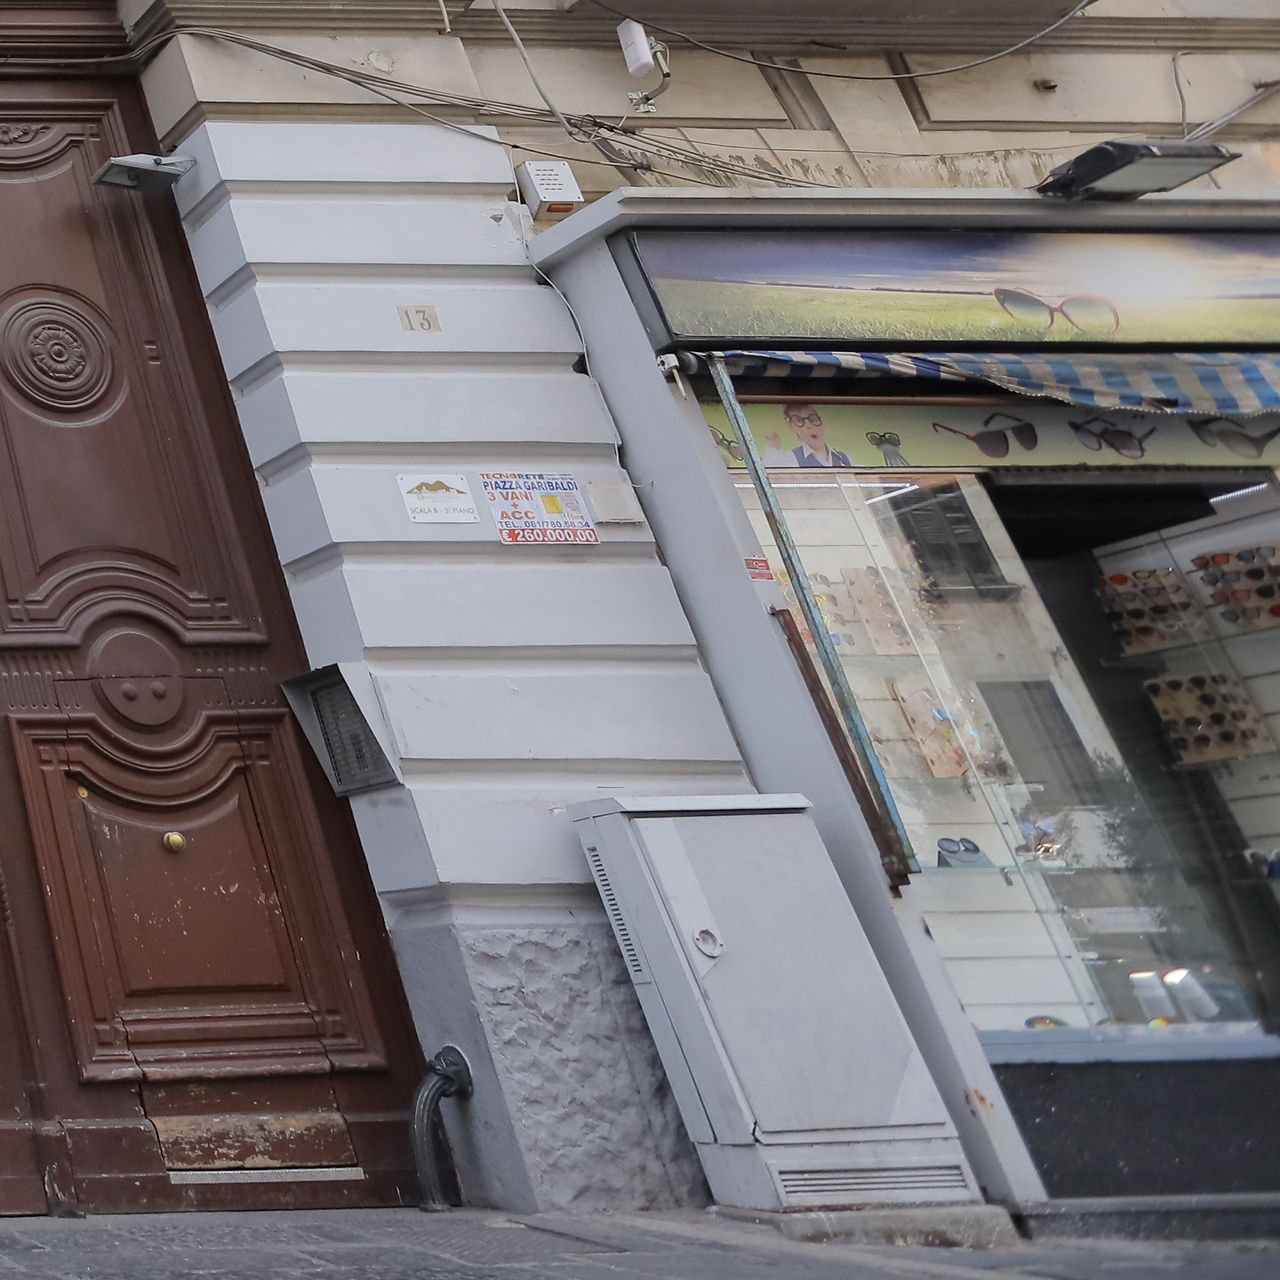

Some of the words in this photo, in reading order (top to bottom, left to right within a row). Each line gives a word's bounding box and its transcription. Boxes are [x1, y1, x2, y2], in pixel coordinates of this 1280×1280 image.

[404, 309, 431, 331] 13
[483, 481, 521, 491] PIAZZA
[524, 481, 578, 491] GARIBALDI
[488, 492, 497, 501] 3
[500, 492, 533, 501] VANI
[500, 511, 536, 520] ACC
[502, 530, 511, 540] €
[514, 530, 596, 542] 260.000,00
